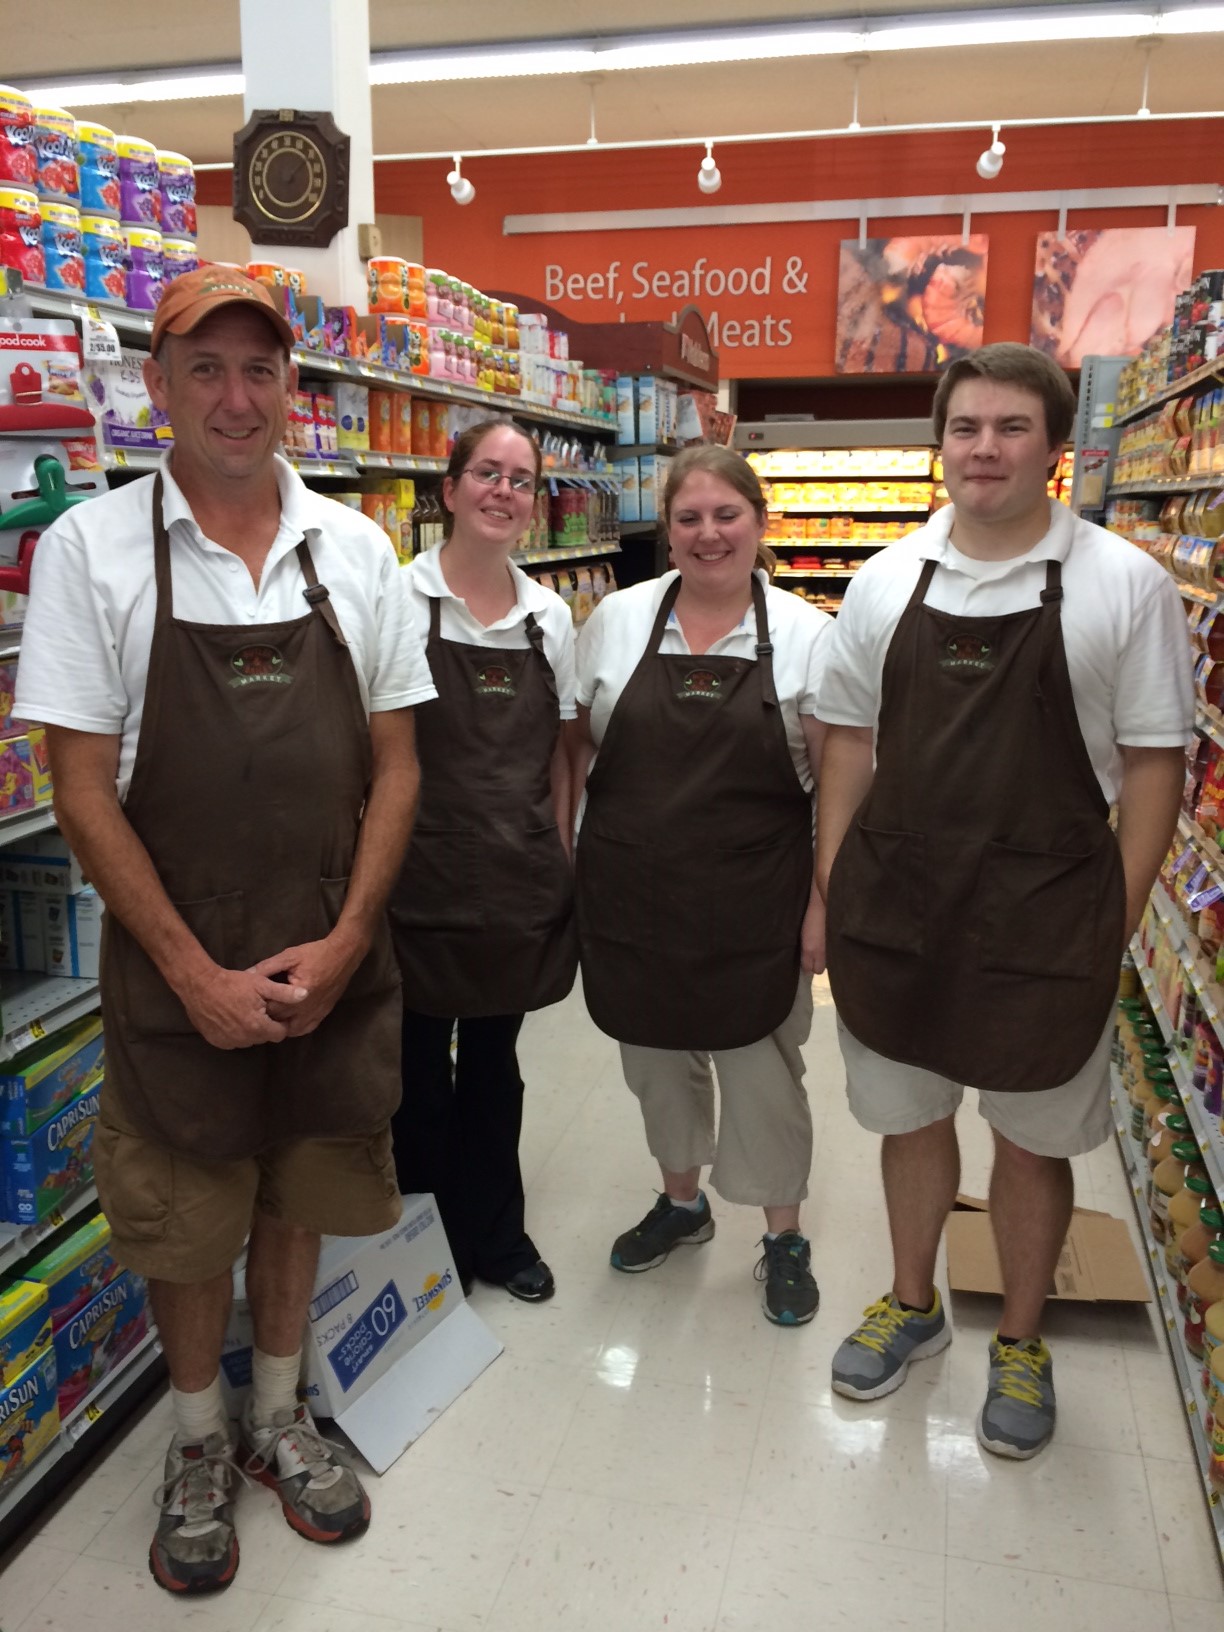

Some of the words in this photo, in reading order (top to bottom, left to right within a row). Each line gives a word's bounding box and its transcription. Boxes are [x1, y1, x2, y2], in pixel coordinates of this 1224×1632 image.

[545, 262, 624, 304] Beef,
[632, 256, 772, 298] Seafood
[781, 255, 809, 295] &
[20, 335, 47, 347] cook
[371, 1293, 396, 1336] 60
[316, 1321, 346, 1347] PACKS
[343, 1331, 373, 1366] calorie
